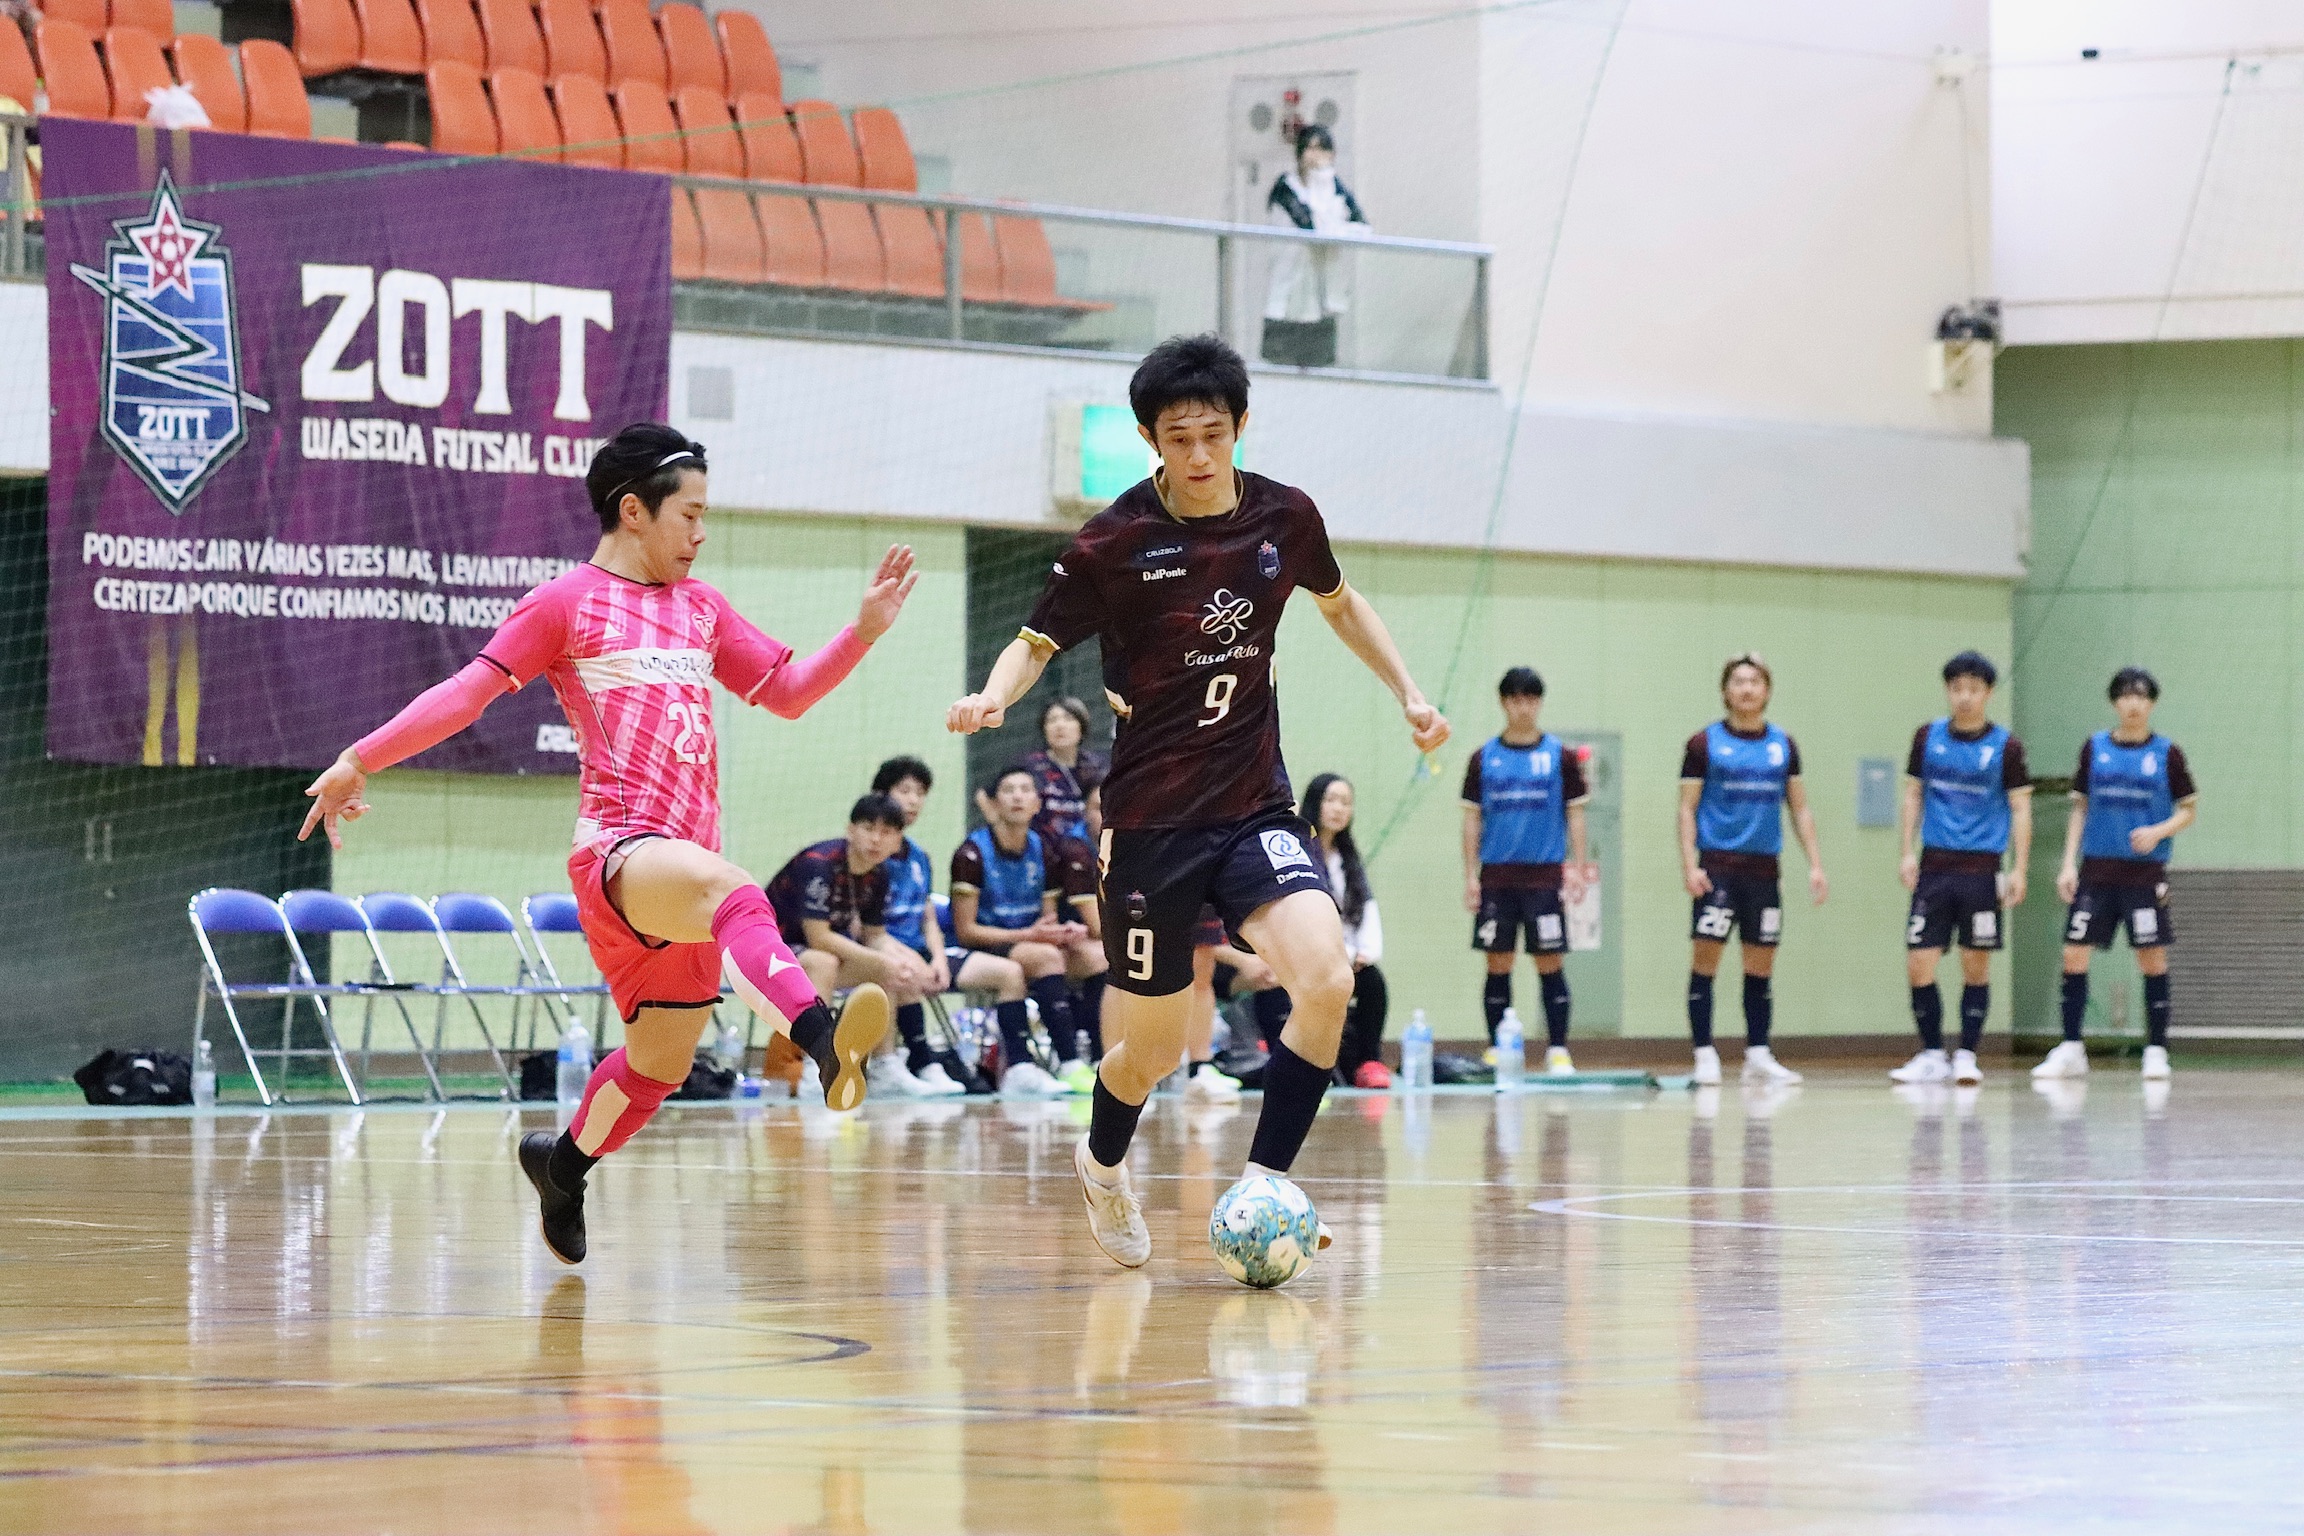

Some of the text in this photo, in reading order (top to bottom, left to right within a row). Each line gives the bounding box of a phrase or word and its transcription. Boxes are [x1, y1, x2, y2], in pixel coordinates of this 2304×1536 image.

[301, 263, 613, 421] ZOTT
[137, 405, 211, 440] ZOTT
[301, 416, 427, 466] WASEDA
[432, 427, 539, 474] FUTSAL
[83, 531, 192, 571] PODEMOS
[191, 539, 242, 571] CAIR
[244, 536, 323, 577] VÁRIAS
[325, 544, 386, 577] VEZES
[1142, 567, 1187, 581] DalPonte
[94, 577, 187, 614] CERTEZA
[186, 582, 277, 618] PORQUE
[279, 585, 400, 620] CONFIAMOS
[401, 591, 446, 625] NOS
[1198, 674, 1238, 727] 9
[667, 701, 711, 765] 25
[1478, 919, 1497, 946] 4
[1698, 906, 1733, 937] 26
[1907, 915, 1925, 943] 2
[2068, 911, 2091, 940] 5
[1127, 927, 1153, 981] 9
